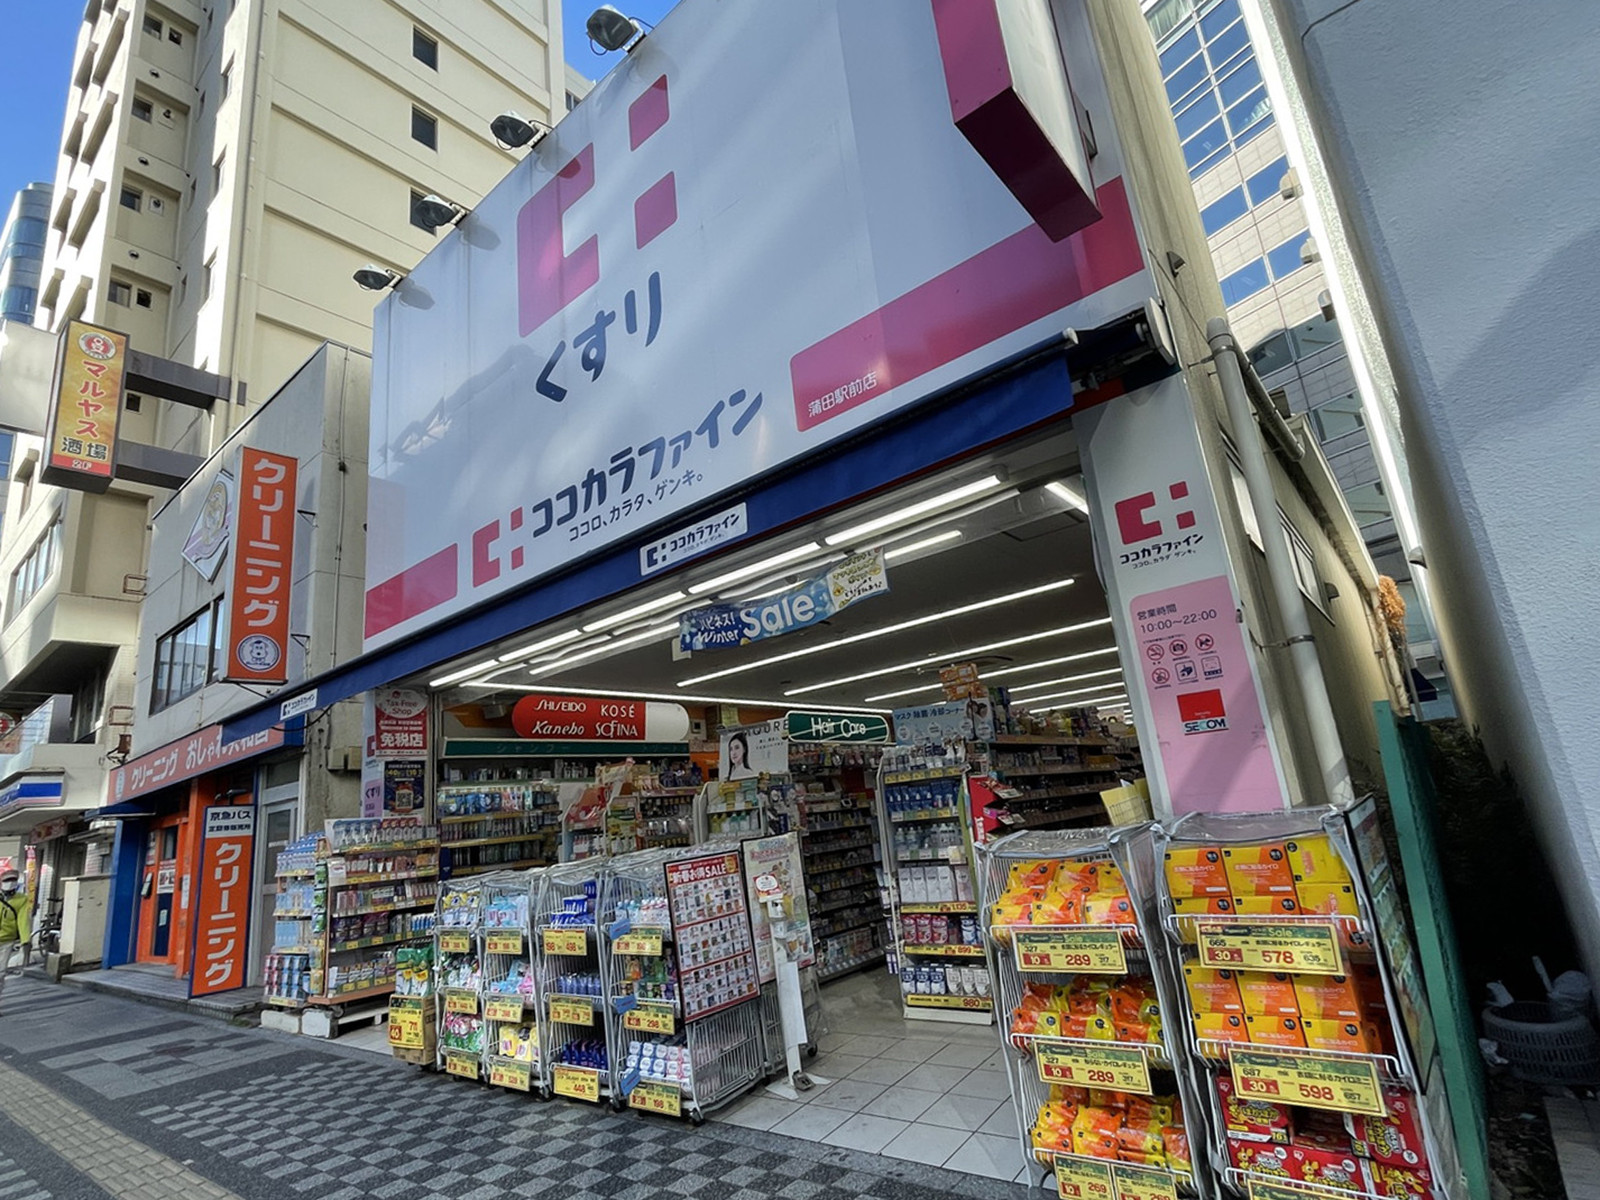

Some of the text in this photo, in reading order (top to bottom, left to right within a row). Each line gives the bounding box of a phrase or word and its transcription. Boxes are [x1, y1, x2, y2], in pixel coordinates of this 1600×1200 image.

[535, 271, 662, 403] くすり
[75, 359, 107, 438] マルヤス
[808, 370, 877, 418] 蒲田駅前店
[61, 436, 108, 461] 酒場
[532, 389, 763, 538] ココカラファイン
[670, 513, 740, 552] ココカラファイン
[243, 458, 287, 627] クリーニング
[1119, 533, 1204, 565] ココカラファイン
[740, 595, 815, 638] Sale
[1137, 603, 1177, 620] 営業時間
[700, 629, 739, 643] Winter
[534, 699, 587, 712] SHISEIDO
[600, 704, 635, 718] KOSÉ
[532, 721, 585, 735] Kanebo
[595, 721, 638, 738] SOFINA
[811, 717, 866, 738] Hair Care
[1184, 718, 1226, 732] SECOM
[380, 732, 423, 747] 免税店
[131, 748, 179, 791] クリーニング
[210, 810, 252, 821] 京急バス
[205, 843, 242, 987] クリーニング
[1268, 927, 1293, 938] Sale
[1031, 956, 1040, 964] 10
[1065, 954, 1091, 966] 289
[1215, 951, 1231, 960] 30
[1261, 950, 1295, 964] 578
[1051, 1068, 1062, 1077] 10
[1088, 1070, 1115, 1083] 289
[1250, 1081, 1267, 1092] 30
[1299, 1083, 1334, 1100] 598
[1087, 1182, 1107, 1193] 269
